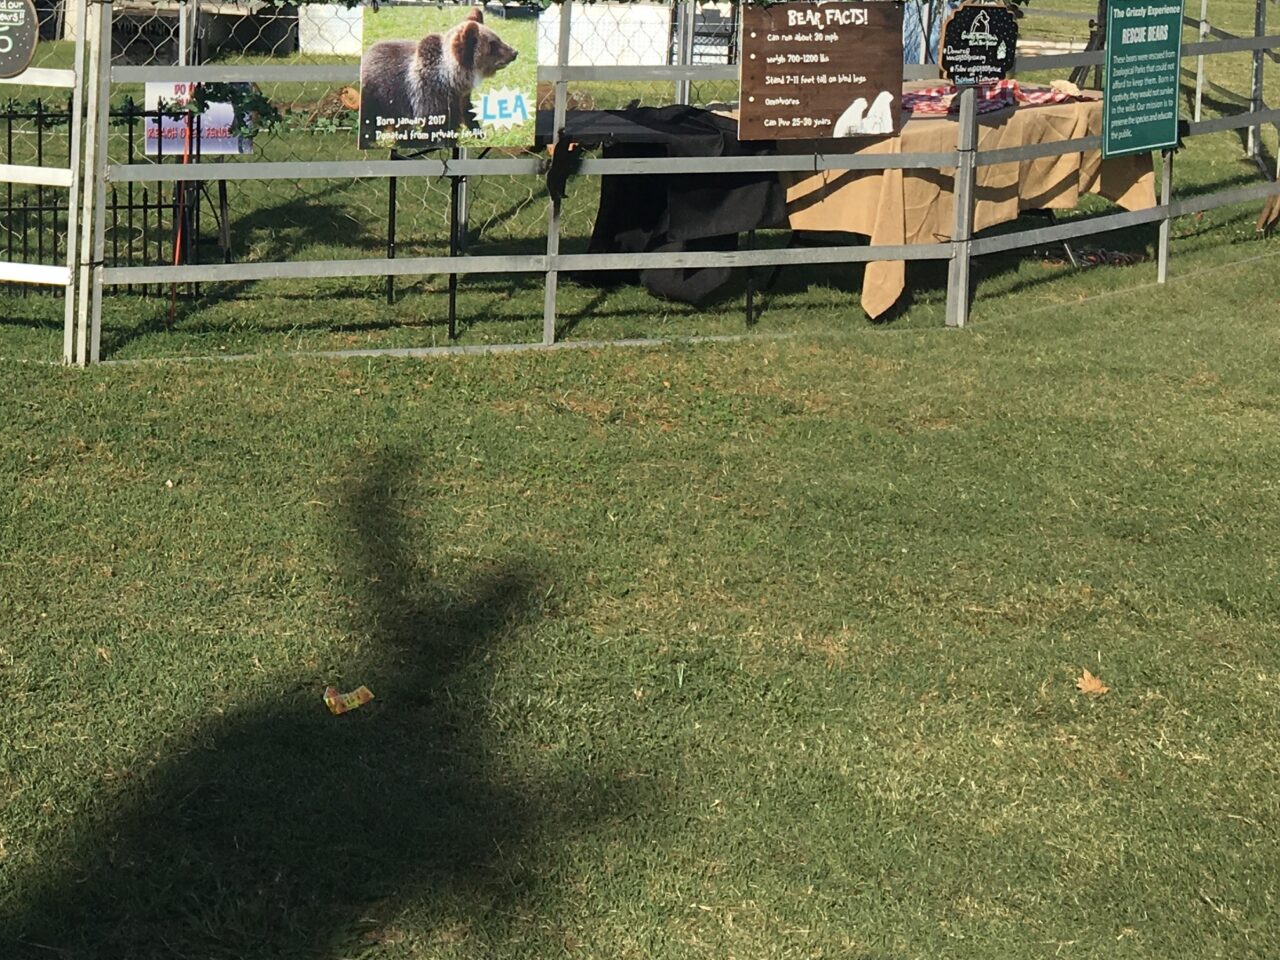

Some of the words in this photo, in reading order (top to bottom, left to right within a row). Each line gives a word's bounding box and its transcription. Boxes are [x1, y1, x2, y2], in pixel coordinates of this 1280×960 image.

[1114, 8, 1124, 18] The
[1126, 6, 1146, 18] Grizzly
[1147, 5, 1181, 16] Experience
[787, 9, 825, 30] BEAR
[825, 9, 868, 26] FACTS!
[794, 33, 813, 41] about
[814, 33, 823, 41] 30
[825, 33, 839, 43] mph
[1122, 28, 1147, 44] RESCUE
[1147, 25, 1169, 41] BEARS
[787, 54, 819, 63] 700-1200
[765, 75, 784, 85] Stand
[786, 76, 798, 84] 7-11
[765, 97, 800, 106] Omnivores
[482, 95, 528, 121] LEA
[376, 116, 395, 127] Born
[428, 115, 446, 125] 2017
[792, 117, 812, 126] 25-30
[814, 119, 832, 128] years
[375, 131, 408, 141] Donated
[410, 131, 429, 140] from
[431, 130, 458, 141] private
